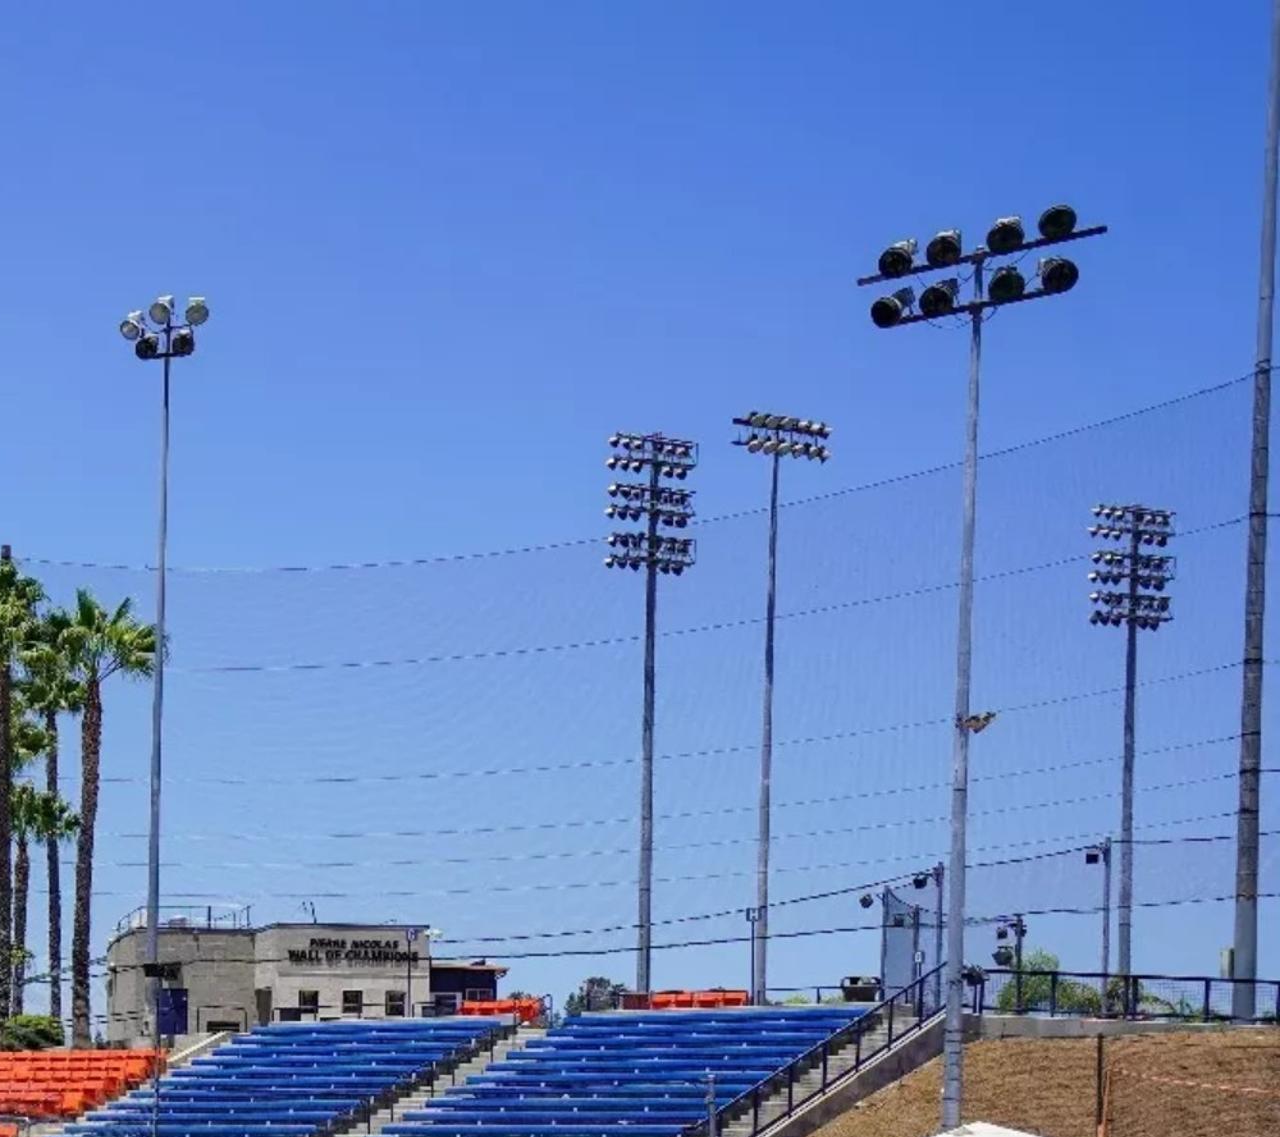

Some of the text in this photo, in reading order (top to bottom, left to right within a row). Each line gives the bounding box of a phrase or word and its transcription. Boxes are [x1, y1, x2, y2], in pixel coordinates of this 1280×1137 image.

[350, 939, 400, 949] NICOLAS
[288, 950, 322, 961] WALL
[325, 950, 342, 961] OF
